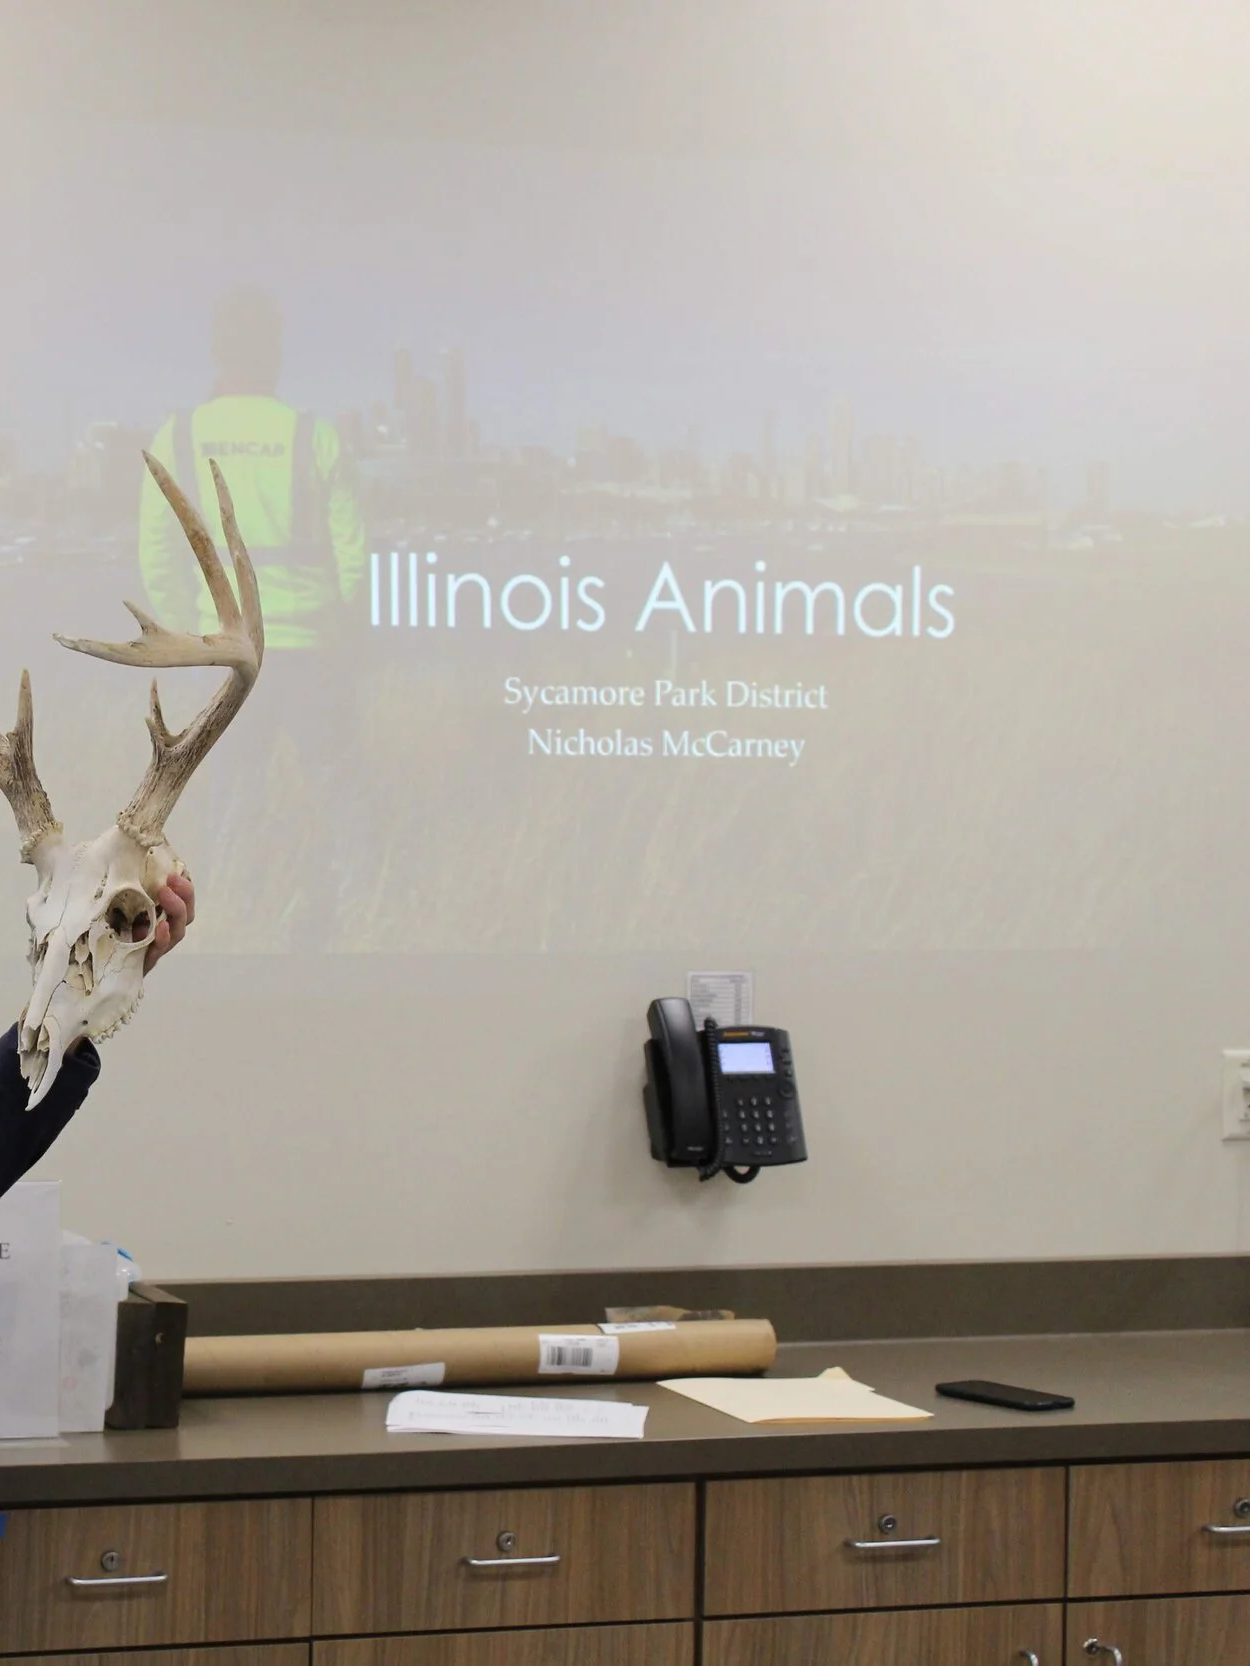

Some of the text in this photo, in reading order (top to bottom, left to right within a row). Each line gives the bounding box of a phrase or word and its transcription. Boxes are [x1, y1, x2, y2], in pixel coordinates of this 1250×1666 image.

[370, 551, 956, 639] Illinois Animals
[503, 676, 829, 714] Sycamore Park District
[527, 728, 806, 766] Nicholas McCarney
